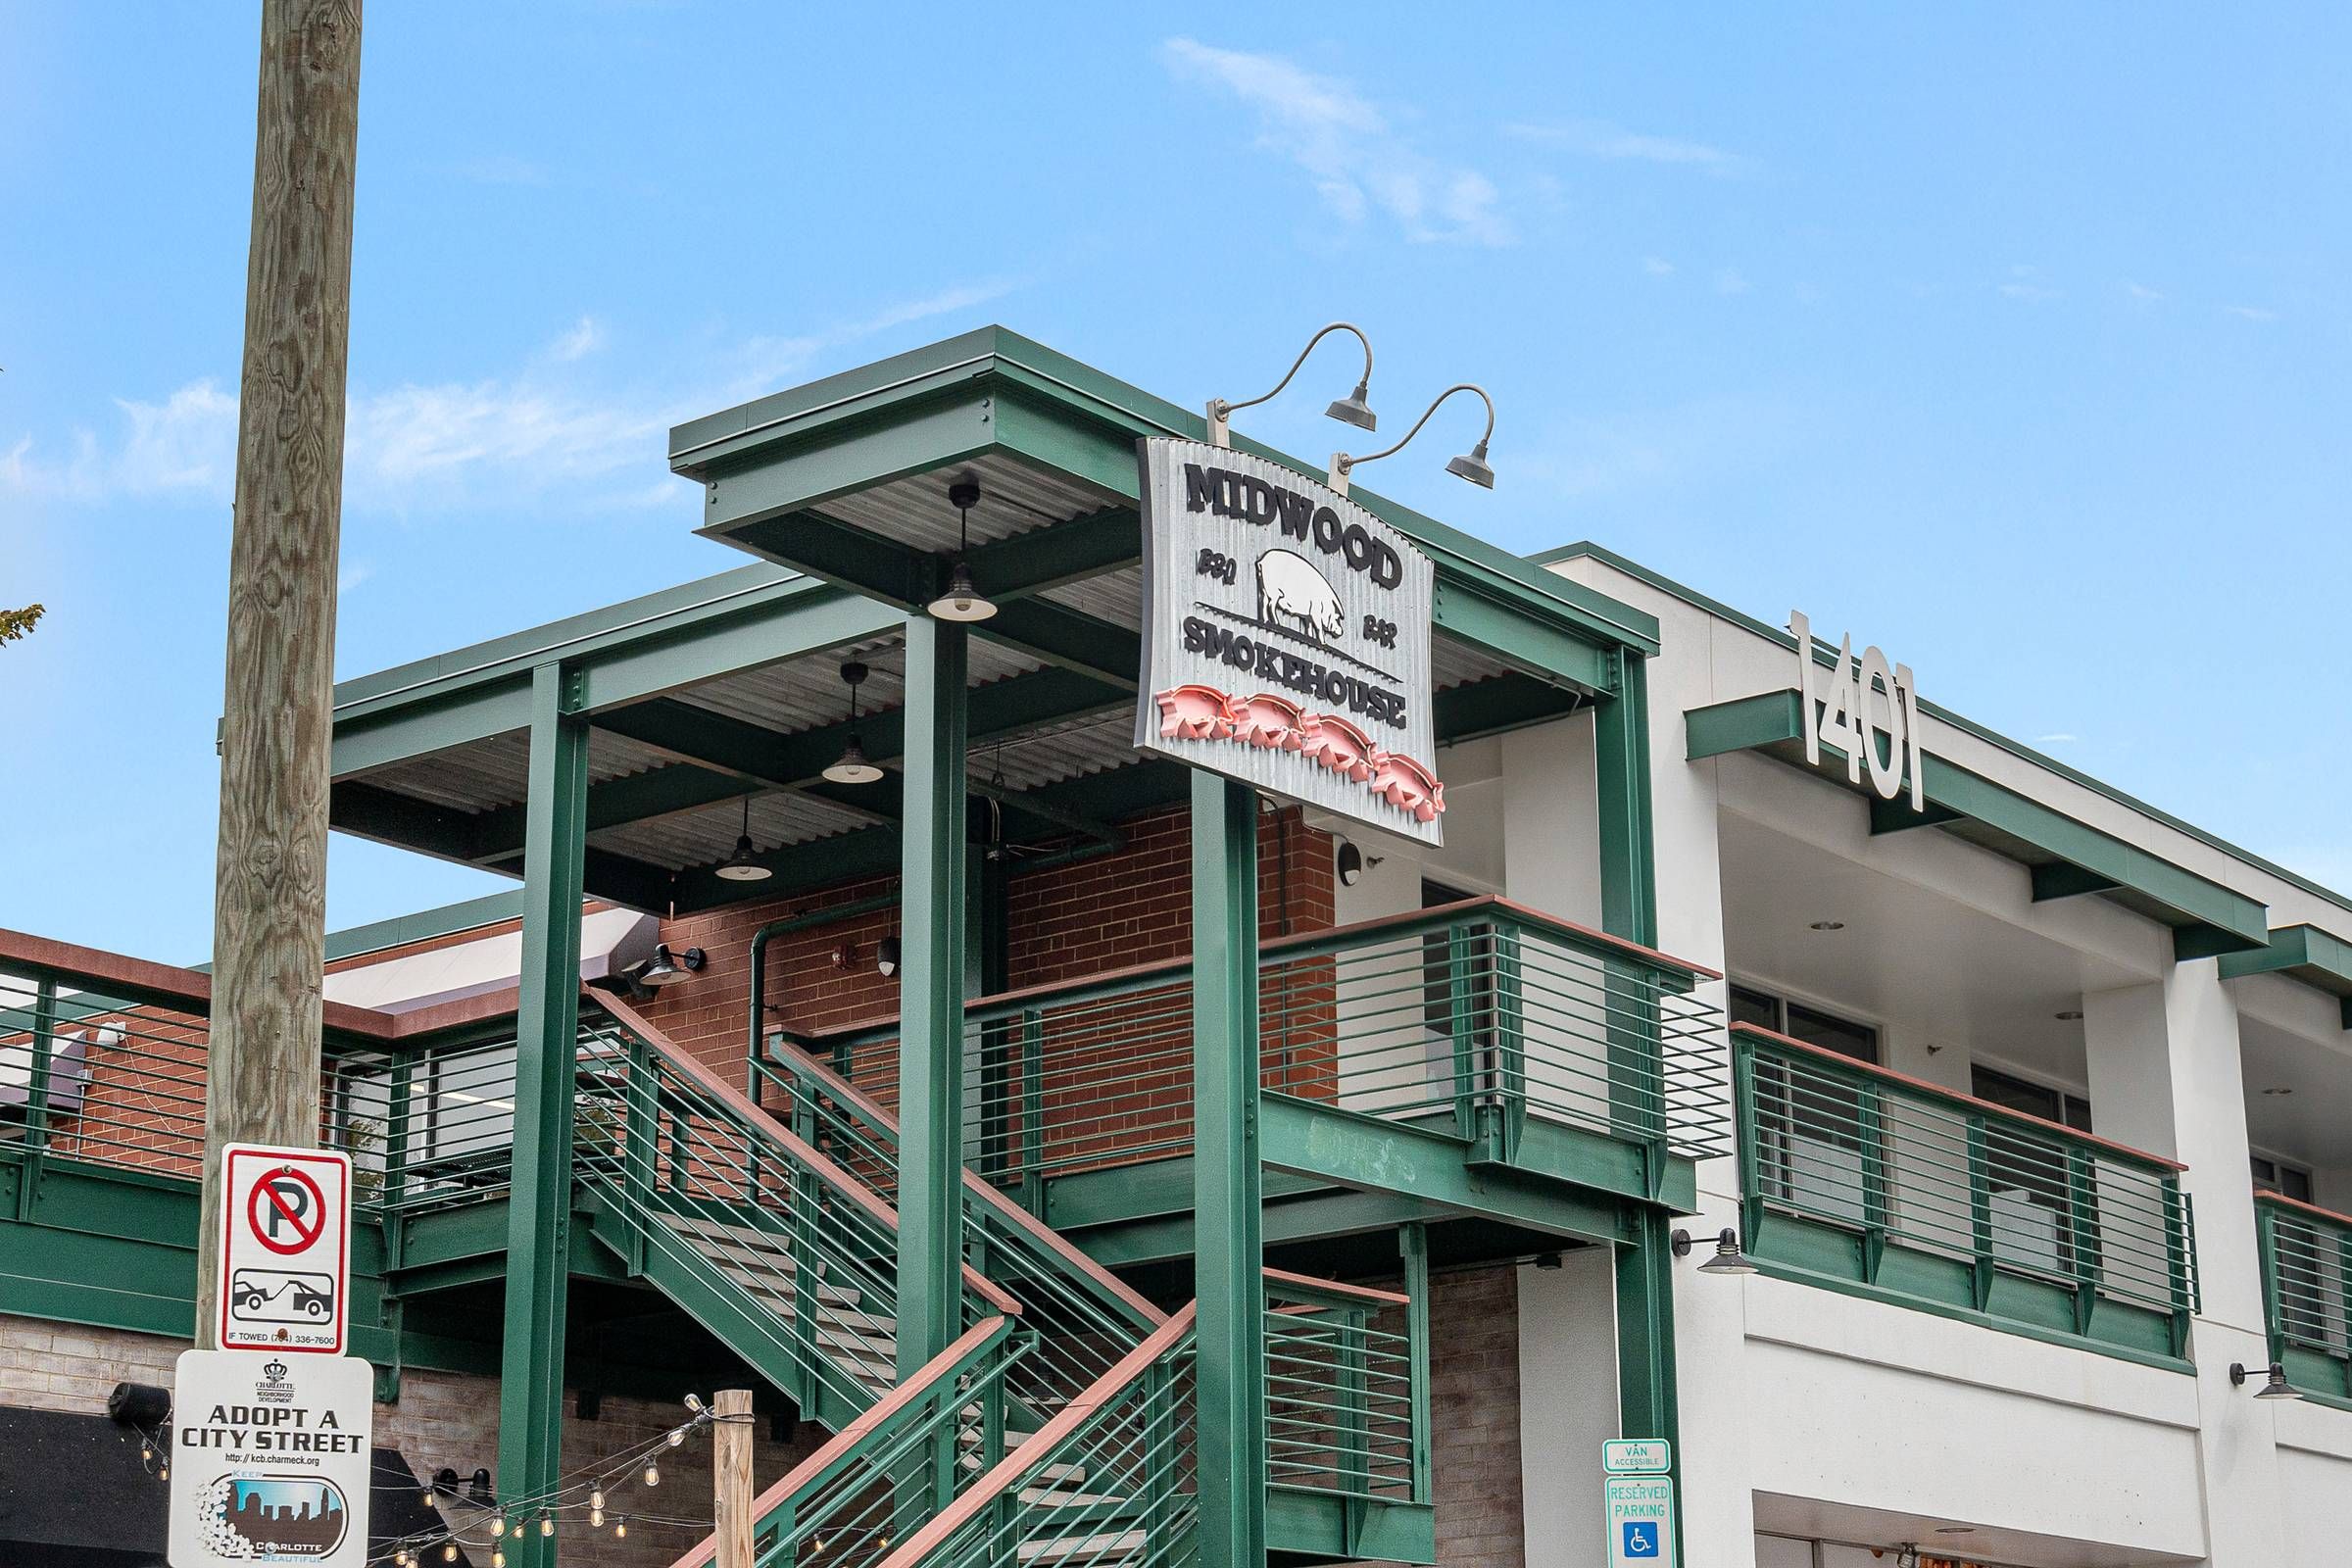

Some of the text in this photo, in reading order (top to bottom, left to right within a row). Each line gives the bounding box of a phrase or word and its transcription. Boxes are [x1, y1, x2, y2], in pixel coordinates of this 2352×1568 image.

[1184, 463, 1402, 591] MIDWOOD
[1198, 548, 1237, 586] BBQ
[1363, 614, 1397, 649] BAR
[1183, 615, 1406, 729] SMOKEHOUSE
[1789, 609, 1923, 812] 1401
[238, 1333, 269, 1342] TOWED
[295, 1335, 335, 1345] 336-7600
[208, 1404, 340, 1429] ADOPT A
[181, 1428, 364, 1453] CITY STREET
[1625, 1446, 1647, 1456] VAN
[1610, 1486, 1668, 1500] RESERVED
[1615, 1504, 1665, 1517] PARKING
[256, 1542, 322, 1552] CARLOTTE
